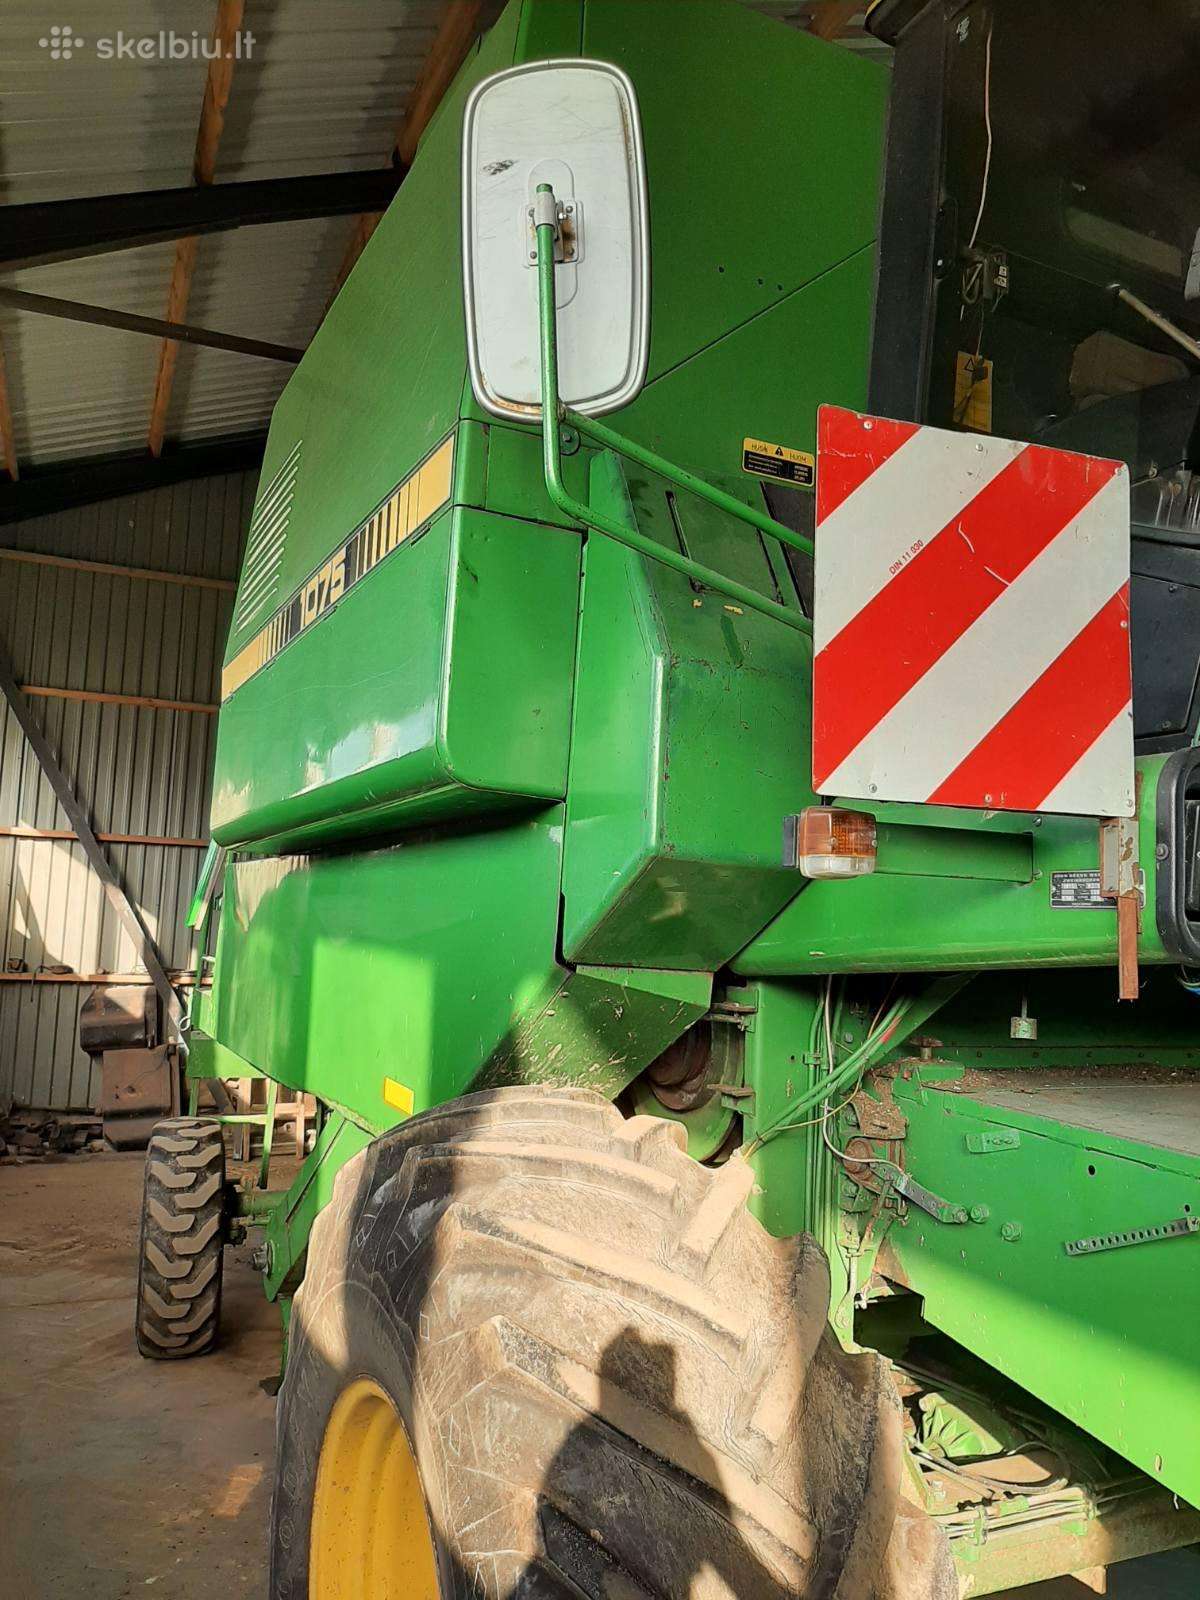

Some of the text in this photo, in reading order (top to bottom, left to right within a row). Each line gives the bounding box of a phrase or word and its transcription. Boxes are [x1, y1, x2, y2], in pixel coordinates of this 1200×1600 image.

[299, 545, 346, 631] 1075
[888, 559, 903, 574] DIN
[902, 551, 912, 562] 11
